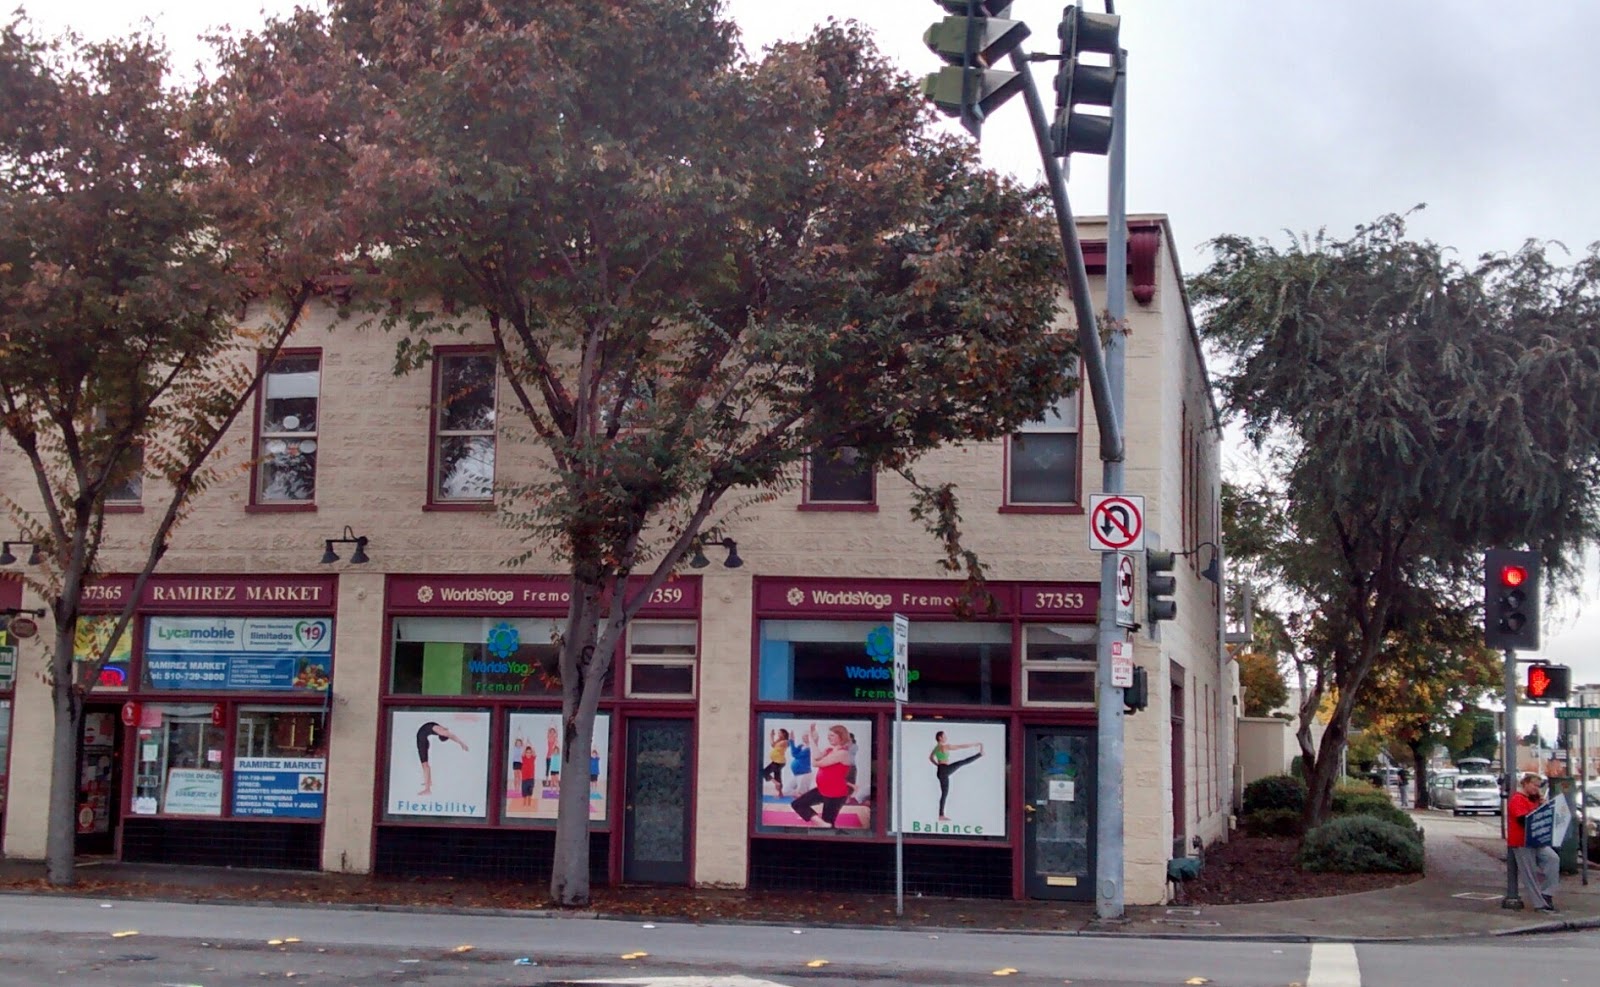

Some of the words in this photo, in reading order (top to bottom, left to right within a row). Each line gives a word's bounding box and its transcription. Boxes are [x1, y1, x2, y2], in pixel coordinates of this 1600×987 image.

[82, 586, 122, 600] 37365
[153, 586, 236, 600] RAMIREZ
[246, 586, 323, 600] MARKET
[440, 588, 514, 605] WorldsYoga
[523, 589, 570, 602] Fremo
[648, 588, 682, 603] 359
[812, 590, 892, 609] WorldsYoga
[902, 593, 954, 606] Fremo
[1035, 593, 1084, 609] 37353
[158, 626, 235, 641] Lycamobile
[148, 661, 188, 670] RAMIREZ
[189, 661, 226, 670] MARKET
[845, 666, 920, 684] WorldsYga
[896, 662, 907, 693] 30
[855, 688, 896, 699] Fremo
[239, 761, 281, 769] RAMIREZ
[283, 761, 323, 769] MARKET
[397, 800, 477, 815] Flexibility
[913, 821, 984, 835] Balance
